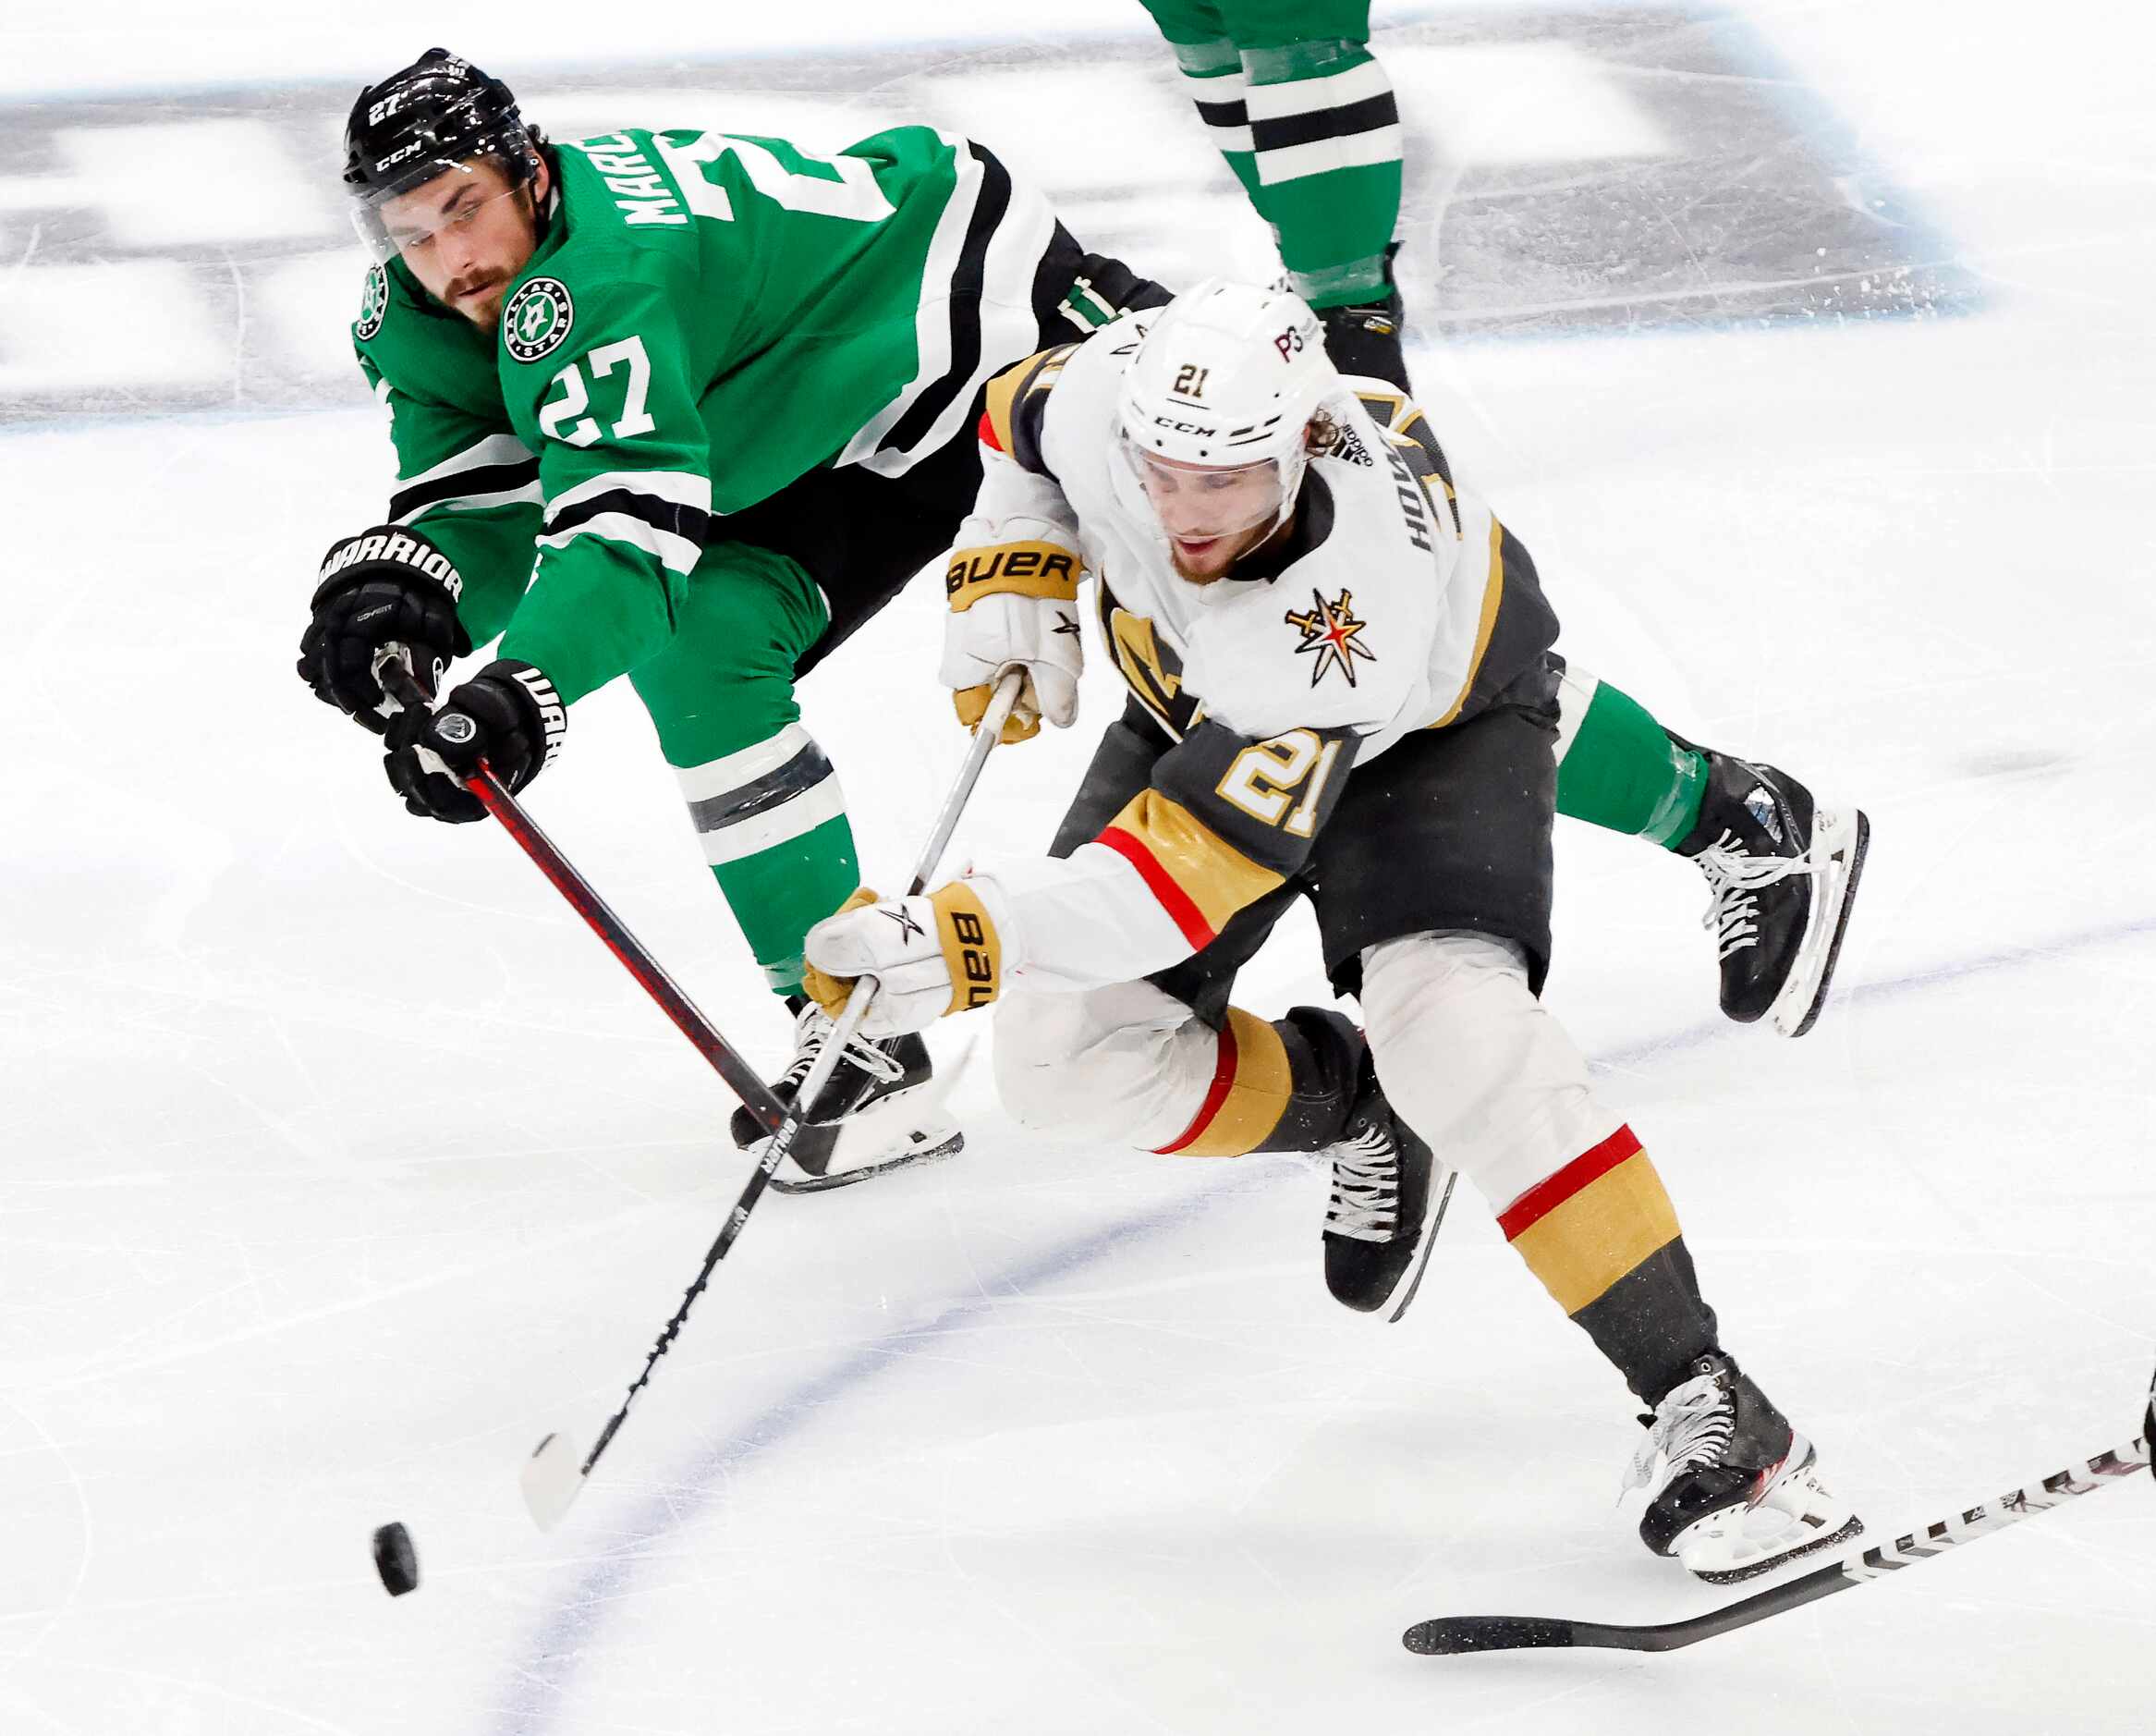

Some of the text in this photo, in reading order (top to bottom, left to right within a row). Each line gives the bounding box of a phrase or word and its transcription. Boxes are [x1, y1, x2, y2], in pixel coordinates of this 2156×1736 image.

[369, 92, 403, 127] 27
[375, 140, 422, 172] CCM
[506, 282, 568, 357] DALLAS STARS
[539, 335, 656, 447] 27
[1173, 363, 1211, 398] 21
[1154, 416, 1217, 437] CCM
[1343, 423, 1374, 468] adidas
[318, 533, 463, 602] WARRIOR
[945, 551, 1073, 593] AUER
[511, 667, 566, 767] WAR
[1214, 727, 1343, 838] 21
